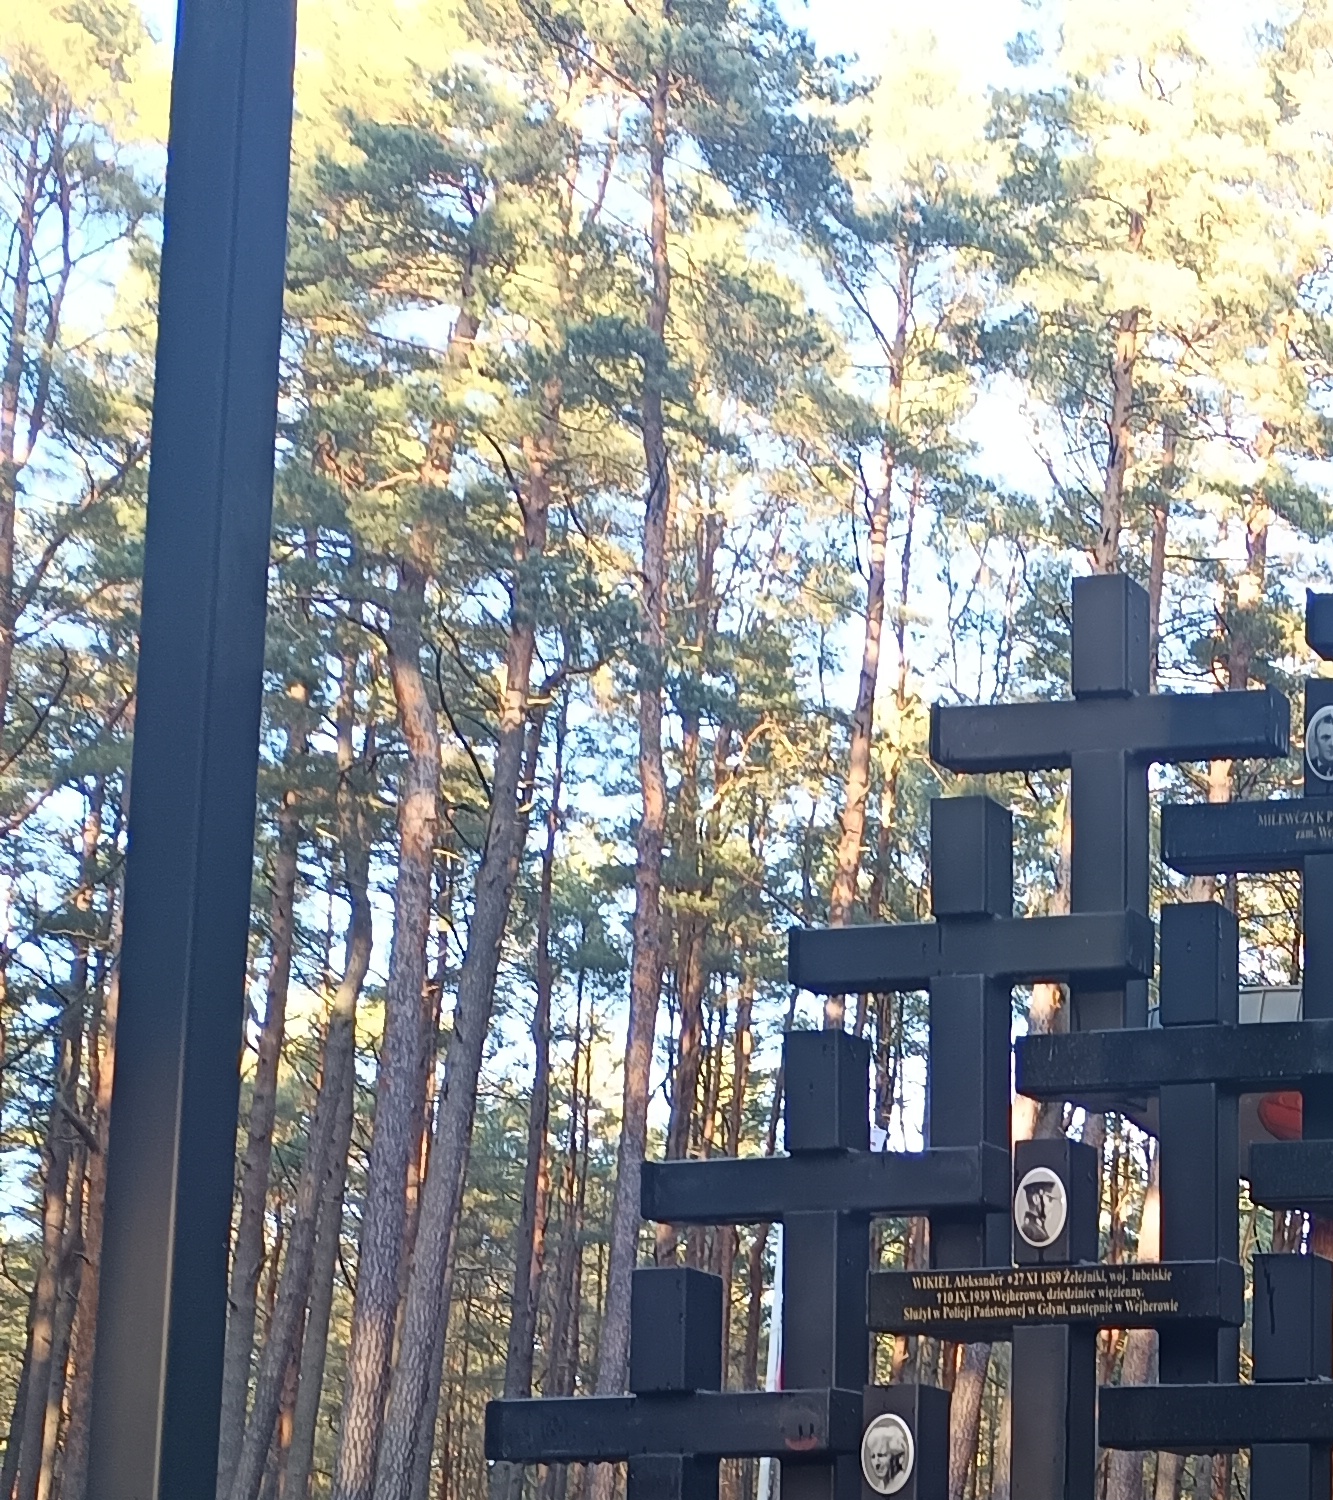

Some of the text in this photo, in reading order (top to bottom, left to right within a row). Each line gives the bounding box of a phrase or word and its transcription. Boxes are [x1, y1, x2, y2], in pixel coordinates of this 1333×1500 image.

[954, 1268, 1172, 1288] Aleksander lubelskie
[991, 1289, 1045, 1304] Wejherowo,
[973, 1299, 1178, 1319] Państwowej Gdyni, następnie Wejherowie
